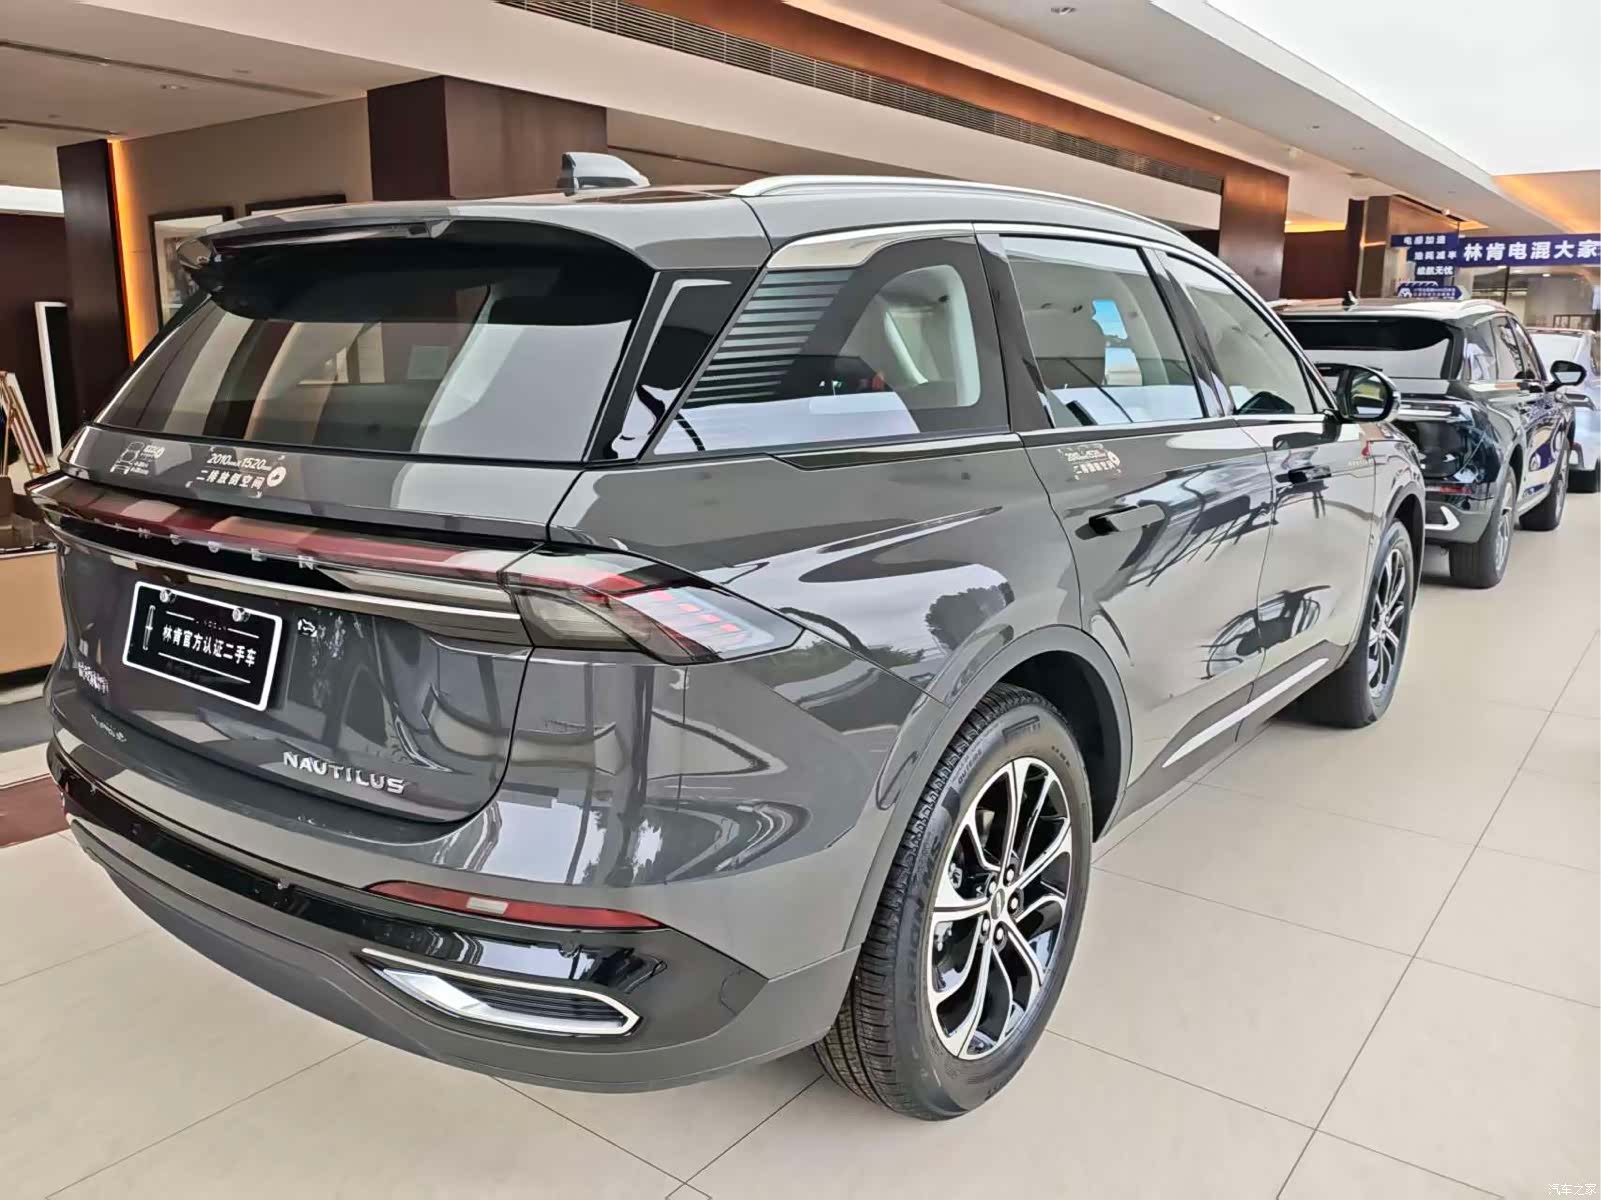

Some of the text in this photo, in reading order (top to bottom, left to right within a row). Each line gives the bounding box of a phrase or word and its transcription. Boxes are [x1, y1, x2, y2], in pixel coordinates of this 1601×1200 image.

[1463, 239, 1601, 262] 林肯电混大家
[162, 623, 257, 668] 林肯官方认证二手车
[283, 751, 405, 794] NAUTILUS
